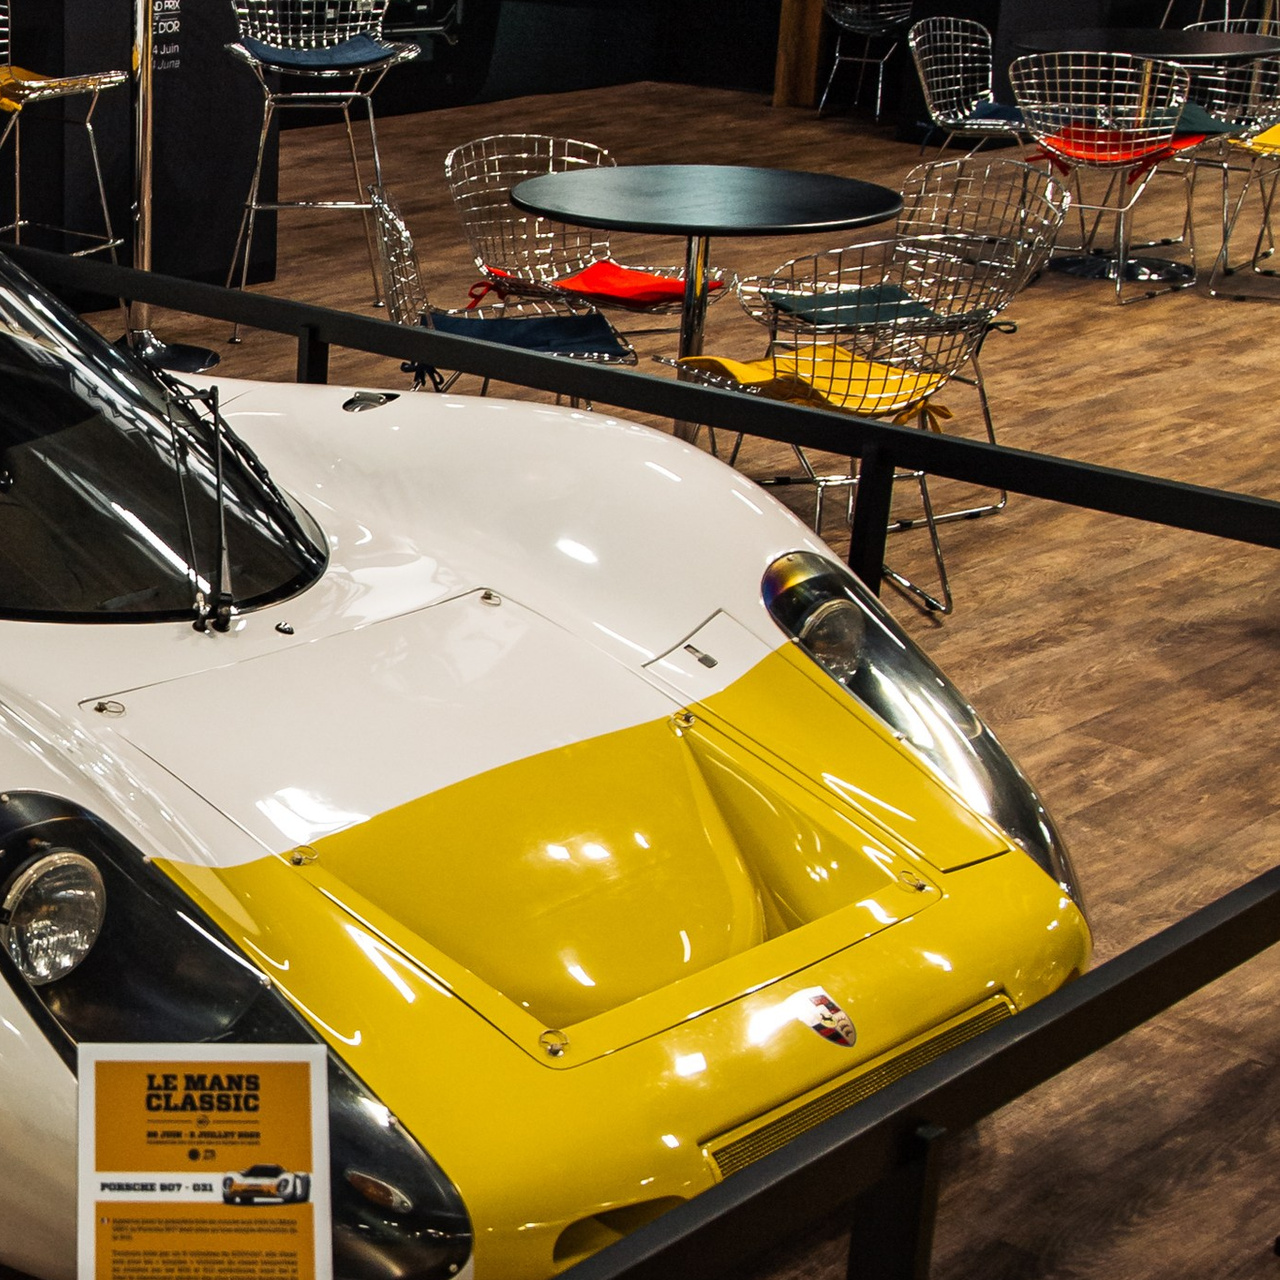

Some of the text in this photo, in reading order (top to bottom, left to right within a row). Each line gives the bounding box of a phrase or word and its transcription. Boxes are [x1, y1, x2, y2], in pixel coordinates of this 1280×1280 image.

[164, 0, 180, 11] PRIX
[160, 44, 180, 55] Juin
[147, 1074, 260, 1091] LE MANS
[146, 1093, 260, 1112] CLASSIC
[100, 1182, 156, 1192] PORSCHE
[159, 1182, 183, 1192] 907
